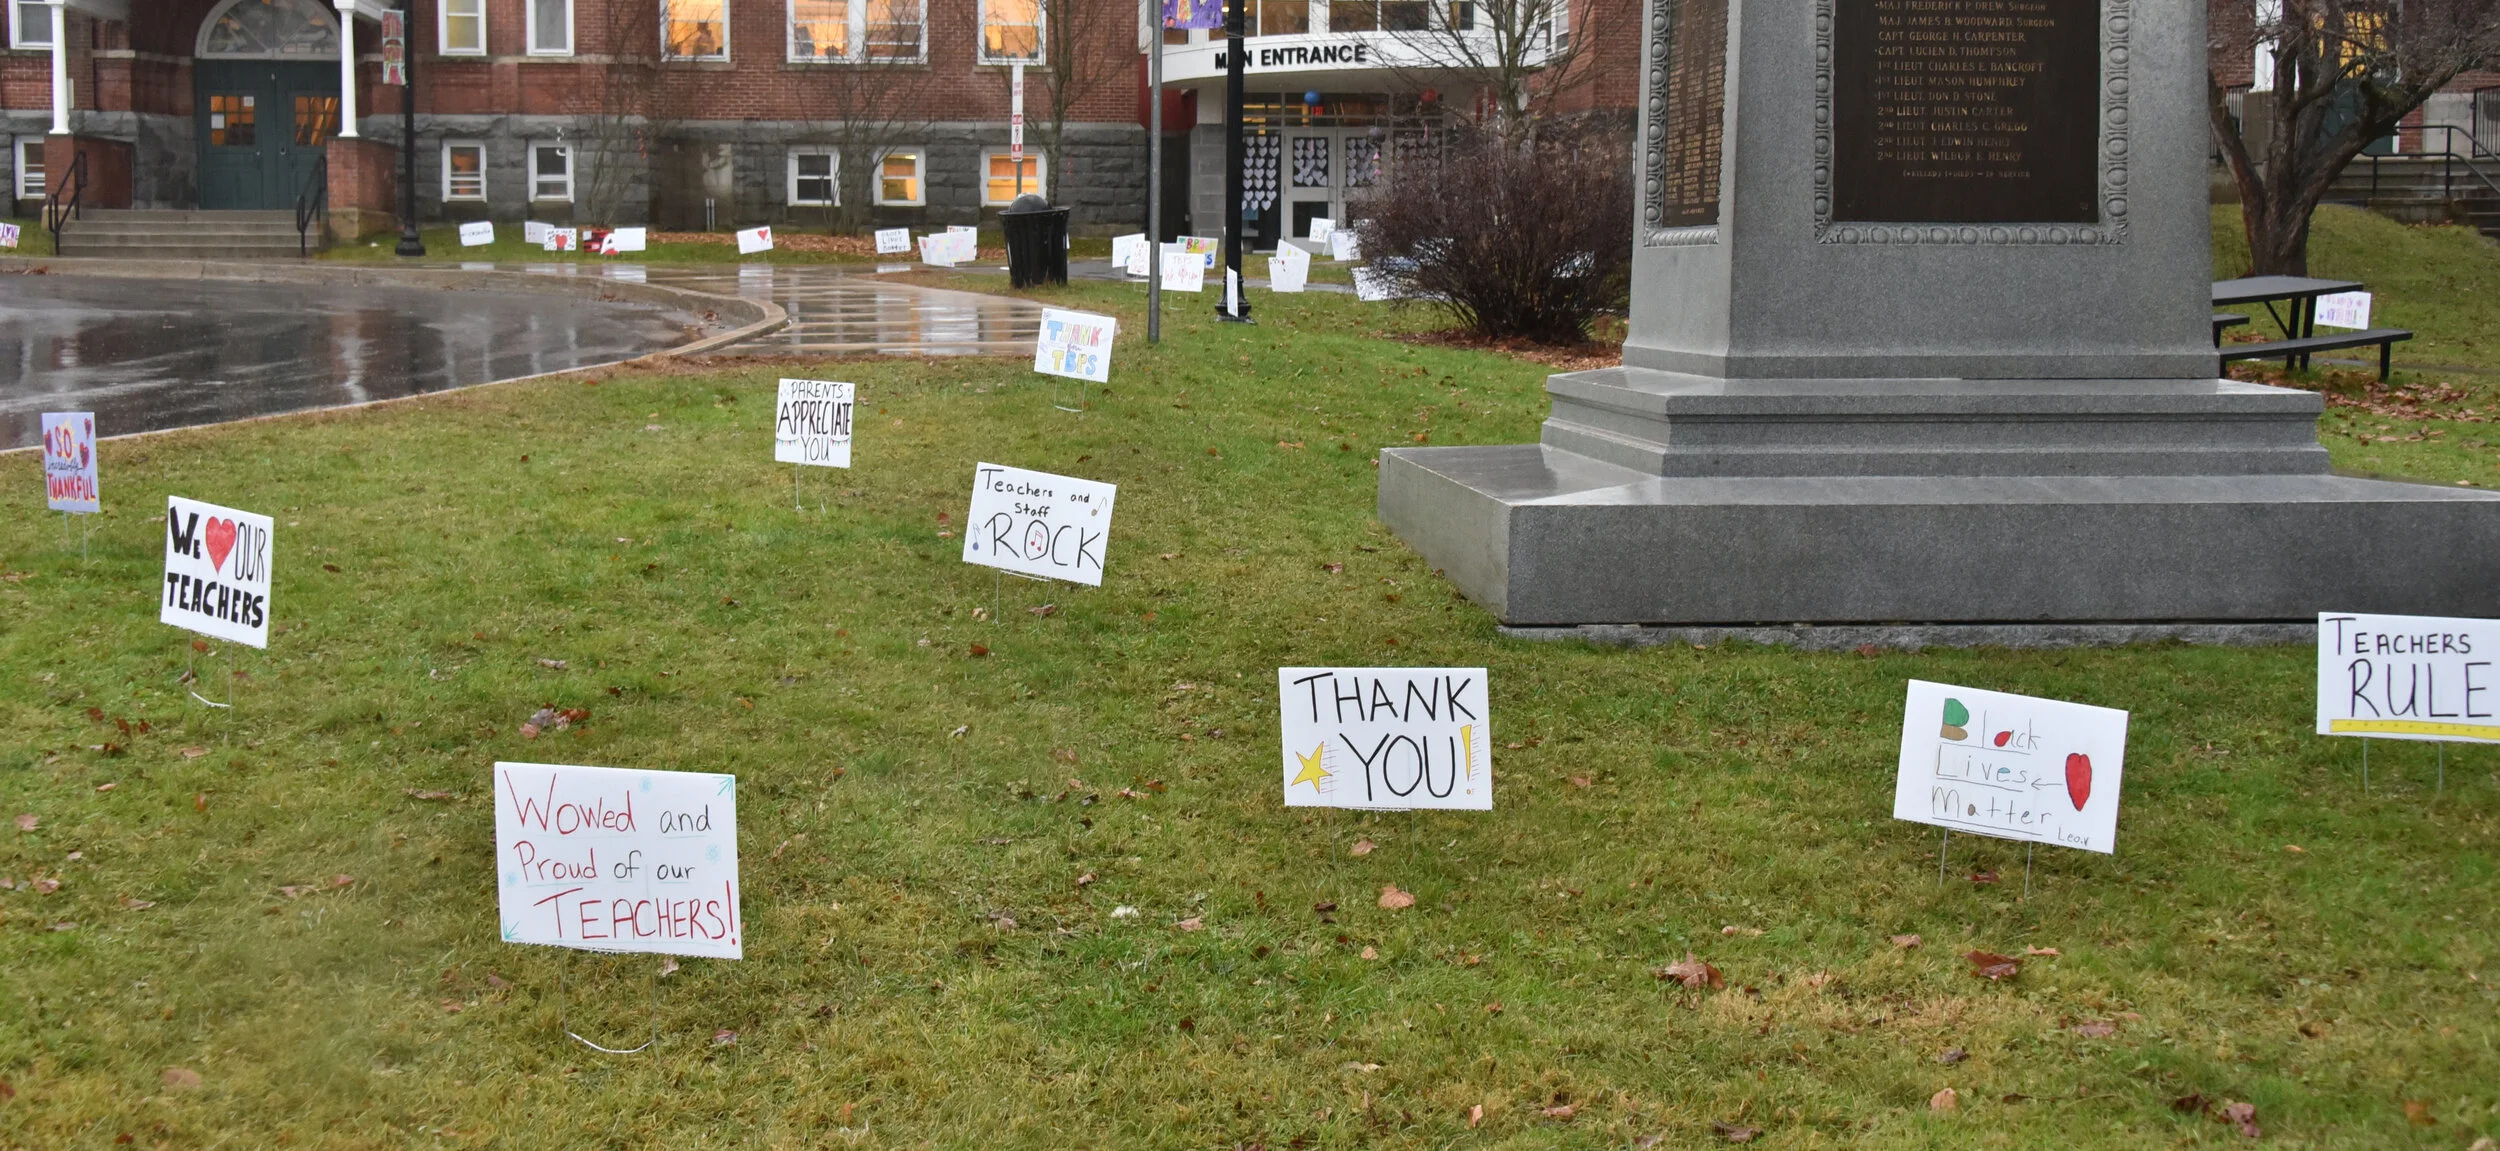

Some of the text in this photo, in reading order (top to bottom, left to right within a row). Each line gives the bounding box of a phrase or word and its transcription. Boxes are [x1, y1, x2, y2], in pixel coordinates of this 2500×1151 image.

[1909, 31, 1949, 41] GEORGE
[1964, 31, 2026, 42] CARPENTER
[1909, 46, 1945, 56] LUCIEN
[1960, 46, 2016, 56] THOMPSON
[1215, 44, 1367, 69] MN ENTRANCE
[1928, 61, 1975, 71] CHARLES
[1990, 61, 2045, 72] BANCROFT
[1928, 76, 1965, 86] MASON
[1969, 76, 2026, 87] HUMPHREY
[1964, 91, 1997, 101] STONE
[1931, 121, 1978, 131] CHARLES
[1932, 106, 1968, 116] JUSTIN
[1988, 151, 2023, 162] HENRY
[1047, 320, 1104, 347] THANK
[1052, 350, 1098, 376] TBPS
[791, 381, 844, 399] PARENTS
[777, 400, 852, 436] APPRECIATE
[54, 425, 73, 458] SO
[801, 435, 830, 462] YOU
[47, 473, 96, 502] THANKFUL
[980, 469, 1091, 503] Teachers and
[1014, 502, 1050, 518] Staff
[235, 521, 266, 583] OUR
[984, 512, 1101, 570] ROCK
[167, 572, 264, 628] TEACHERS
[2325, 617, 2472, 656] TEACHERS
[1293, 672, 1477, 724] THANK
[2348, 658, 2492, 718] RULE
[1939, 697, 2042, 750] Black
[1339, 724, 1473, 802] YOU!
[1936, 743, 2030, 783] Lives
[659, 803, 712, 834] and
[1931, 784, 2053, 825] Matter
[513, 840, 696, 882] Proud of our
[532, 880, 737, 946] TEACHERS!
